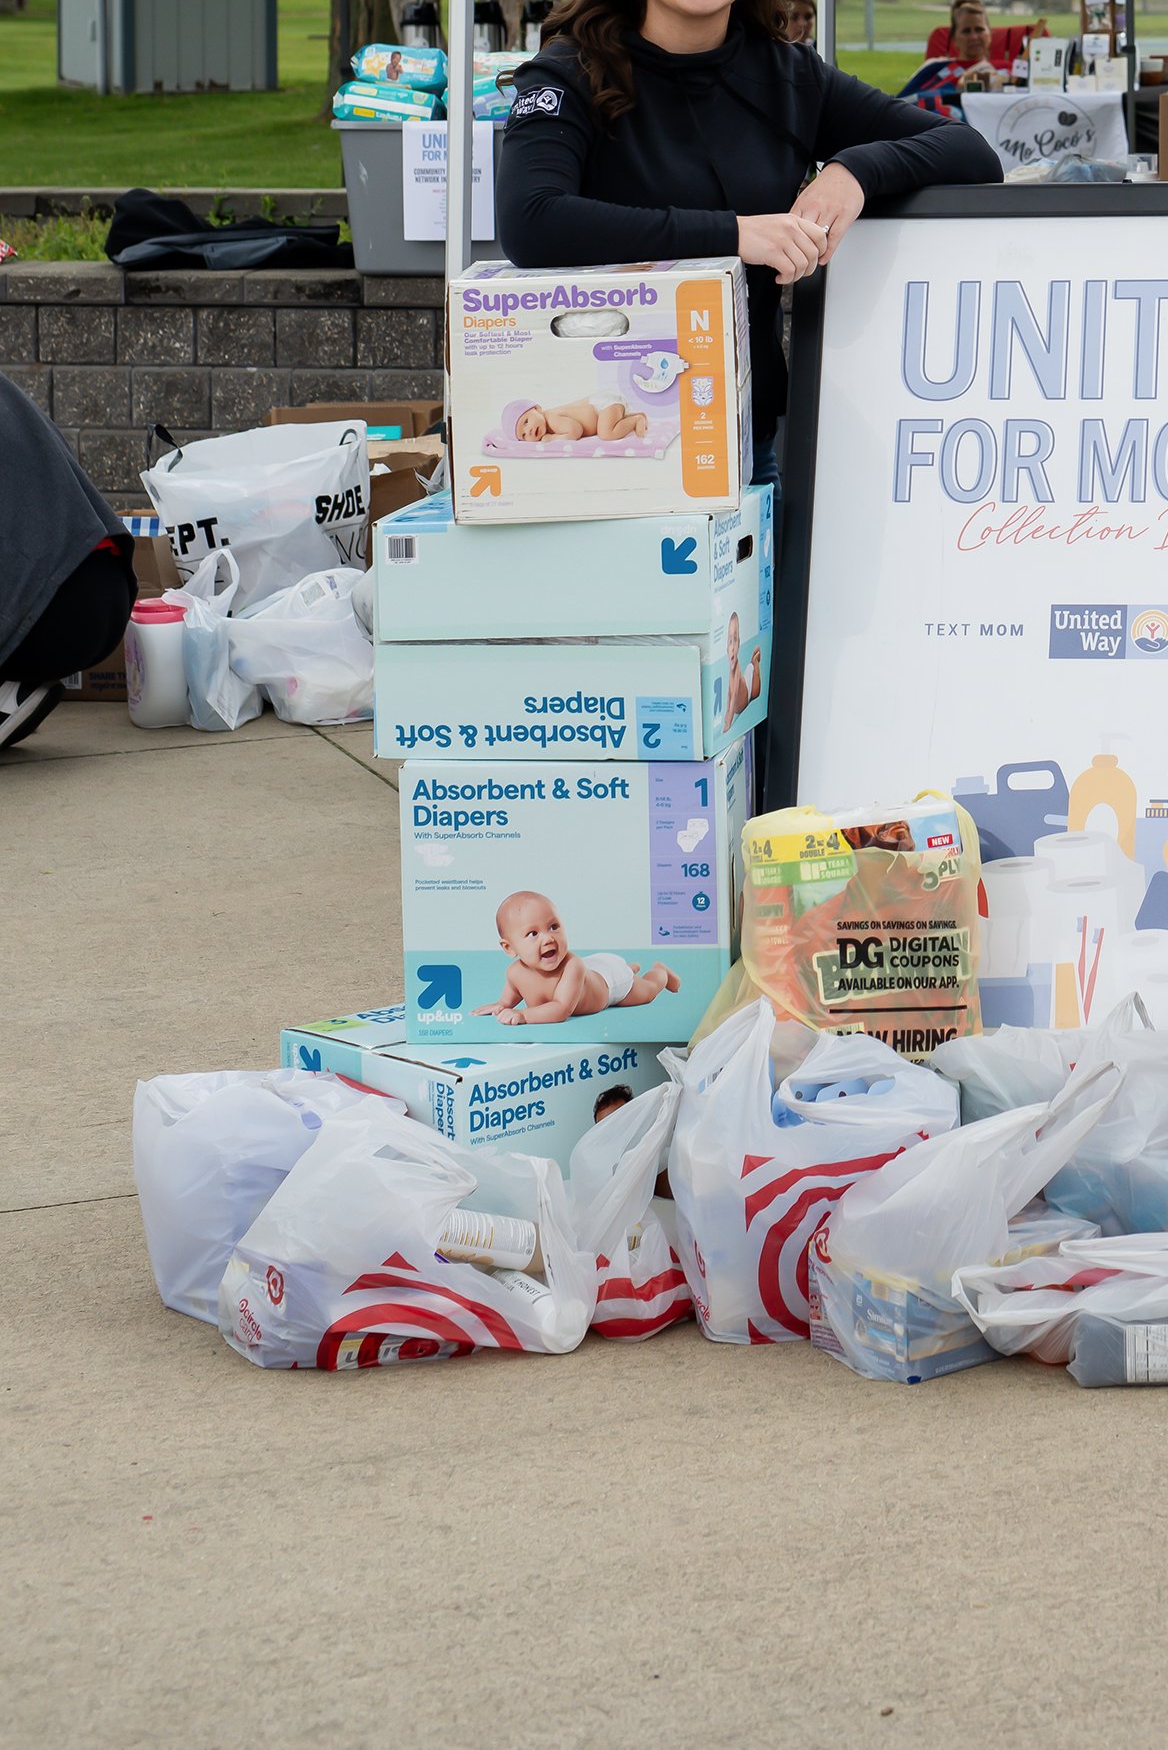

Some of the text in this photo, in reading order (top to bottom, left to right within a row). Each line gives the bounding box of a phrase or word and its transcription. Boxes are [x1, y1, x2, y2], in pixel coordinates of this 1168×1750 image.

[422, 151, 441, 161] FOR
[462, 282, 658, 317] SuperAbsorb
[463, 315, 517, 331] Diapers
[690, 310, 710, 331] N
[613, 343, 652, 351] SuperAbsorb
[704, 335, 713, 343] lb
[695, 455, 715, 465] 162
[892, 417, 1056, 503] FOR
[315, 484, 366, 525] SHOE
[765, 494, 771, 519] 2
[713, 512, 742, 537] Absorbent
[957, 502, 1151, 550] Collection
[713, 560, 733, 583] Diapers
[924, 623, 1025, 637] TEXT MOM
[1054, 610, 1123, 630] United
[1080, 631, 1122, 656] Way
[524, 691, 625, 720] Diapers
[396, 724, 627, 748] Absorbent & Soft
[642, 723, 661, 748] 2
[412, 777, 630, 801] Absorbent & Soft
[694, 778, 708, 807] 1
[413, 805, 508, 830] Diapers
[434, 832, 483, 840] SuperAbsorb
[485, 831, 521, 839] Channels
[931, 835, 950, 846] NEW
[800, 848, 825, 859] DOUBLE
[828, 859, 844, 868] TEAR
[681, 863, 710, 877] 168
[820, 867, 850, 879] SQUARE
[938, 856, 961, 874] PLY
[837, 920, 927, 930] SAVINGS ON SAVINGS ON
[836, 937, 884, 969] DG
[890, 937, 960, 952] DIGITAL
[890, 955, 960, 968] COUPONS
[837, 977, 960, 990] AVAILABLE ON OUR APP.
[417, 1011, 462, 1024] up&up
[468, 1048, 638, 1107] Absorbent & Soft
[469, 1099, 546, 1134] Diapers
[470, 1119, 556, 1146] With SuperAbsorb Channels
[242, 1307, 262, 1341] circle
